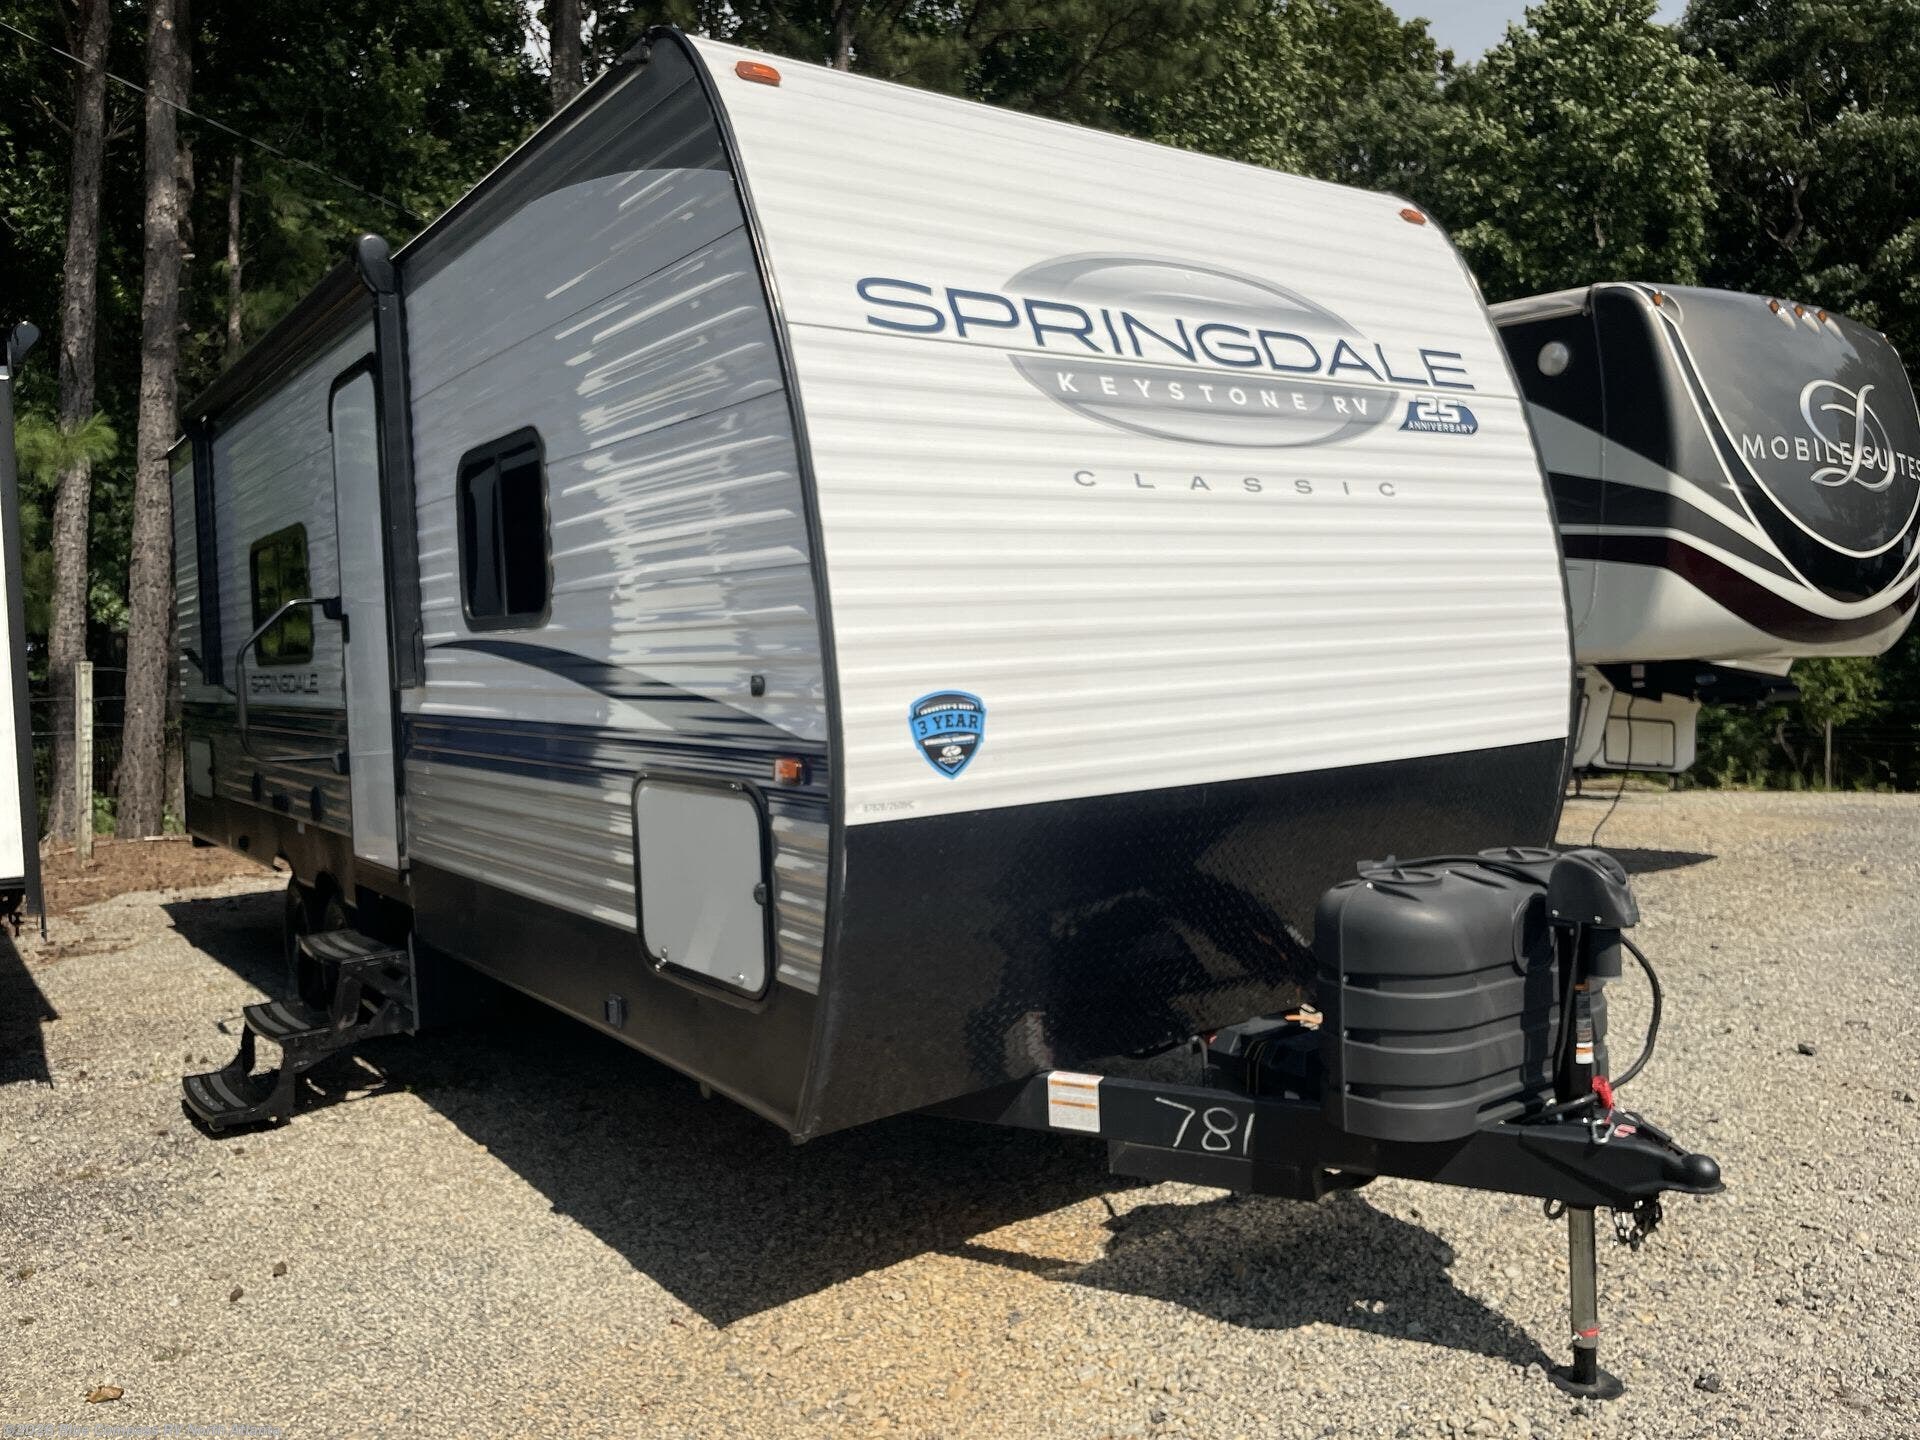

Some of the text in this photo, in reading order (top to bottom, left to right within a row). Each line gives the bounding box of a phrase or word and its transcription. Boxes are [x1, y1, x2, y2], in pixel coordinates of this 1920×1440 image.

[856, 277, 1476, 390] SPRINGDALE
[1057, 371, 1369, 416] KEYSTONE RV
[1416, 397, 1461, 423] 25
[1408, 420, 1474, 434] ANNIVERSARY
[1073, 470, 1396, 497] CLASSIC
[918, 714, 978, 735] 3 YEAR
[1155, 1097, 1255, 1156] 781
